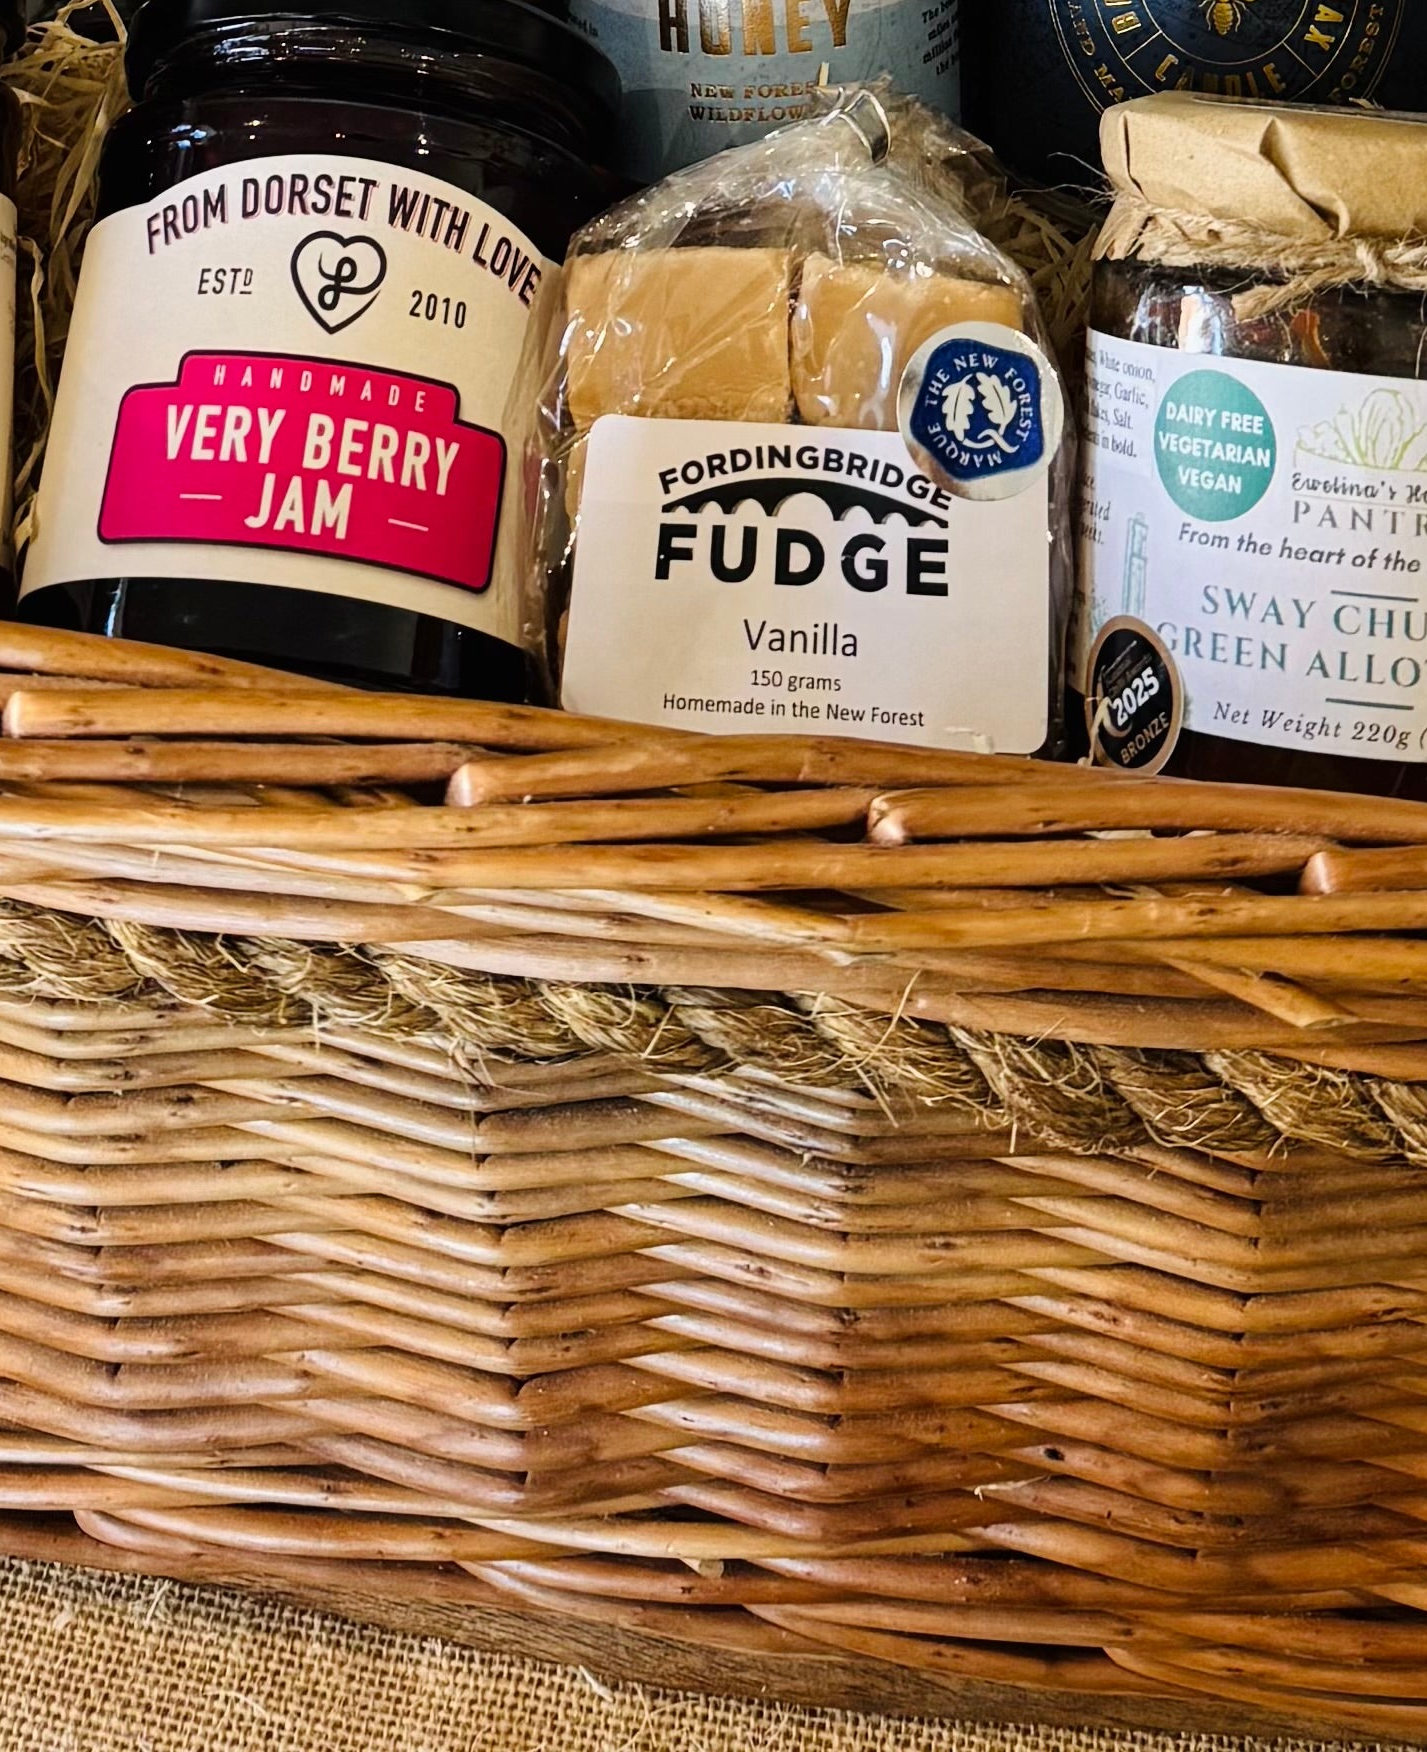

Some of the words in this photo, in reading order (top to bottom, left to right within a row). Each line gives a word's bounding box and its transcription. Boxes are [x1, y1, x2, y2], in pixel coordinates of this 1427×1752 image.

[165, 404, 286, 464] VERY
[301, 413, 461, 496] BERRY
[1158, 432, 1271, 468] VEGETARIAN
[658, 445, 954, 511] FORDINGBRIDGE
[243, 473, 355, 539] JAM
[654, 523, 950, 597] FUDGE
[1201, 584, 1316, 631] SWAY
[743, 618, 859, 658] Vanilla
[750, 669, 783, 688] 150
[788, 672, 842, 692] grams
[663, 693, 765, 716] Homemade
[771, 700, 786, 717] in
[792, 701, 820, 719] the
[826, 704, 865, 722] New
[871, 707, 924, 728] Forest
[1259, 709, 1343, 742] Weight
[1351, 719, 1413, 751] 220g
